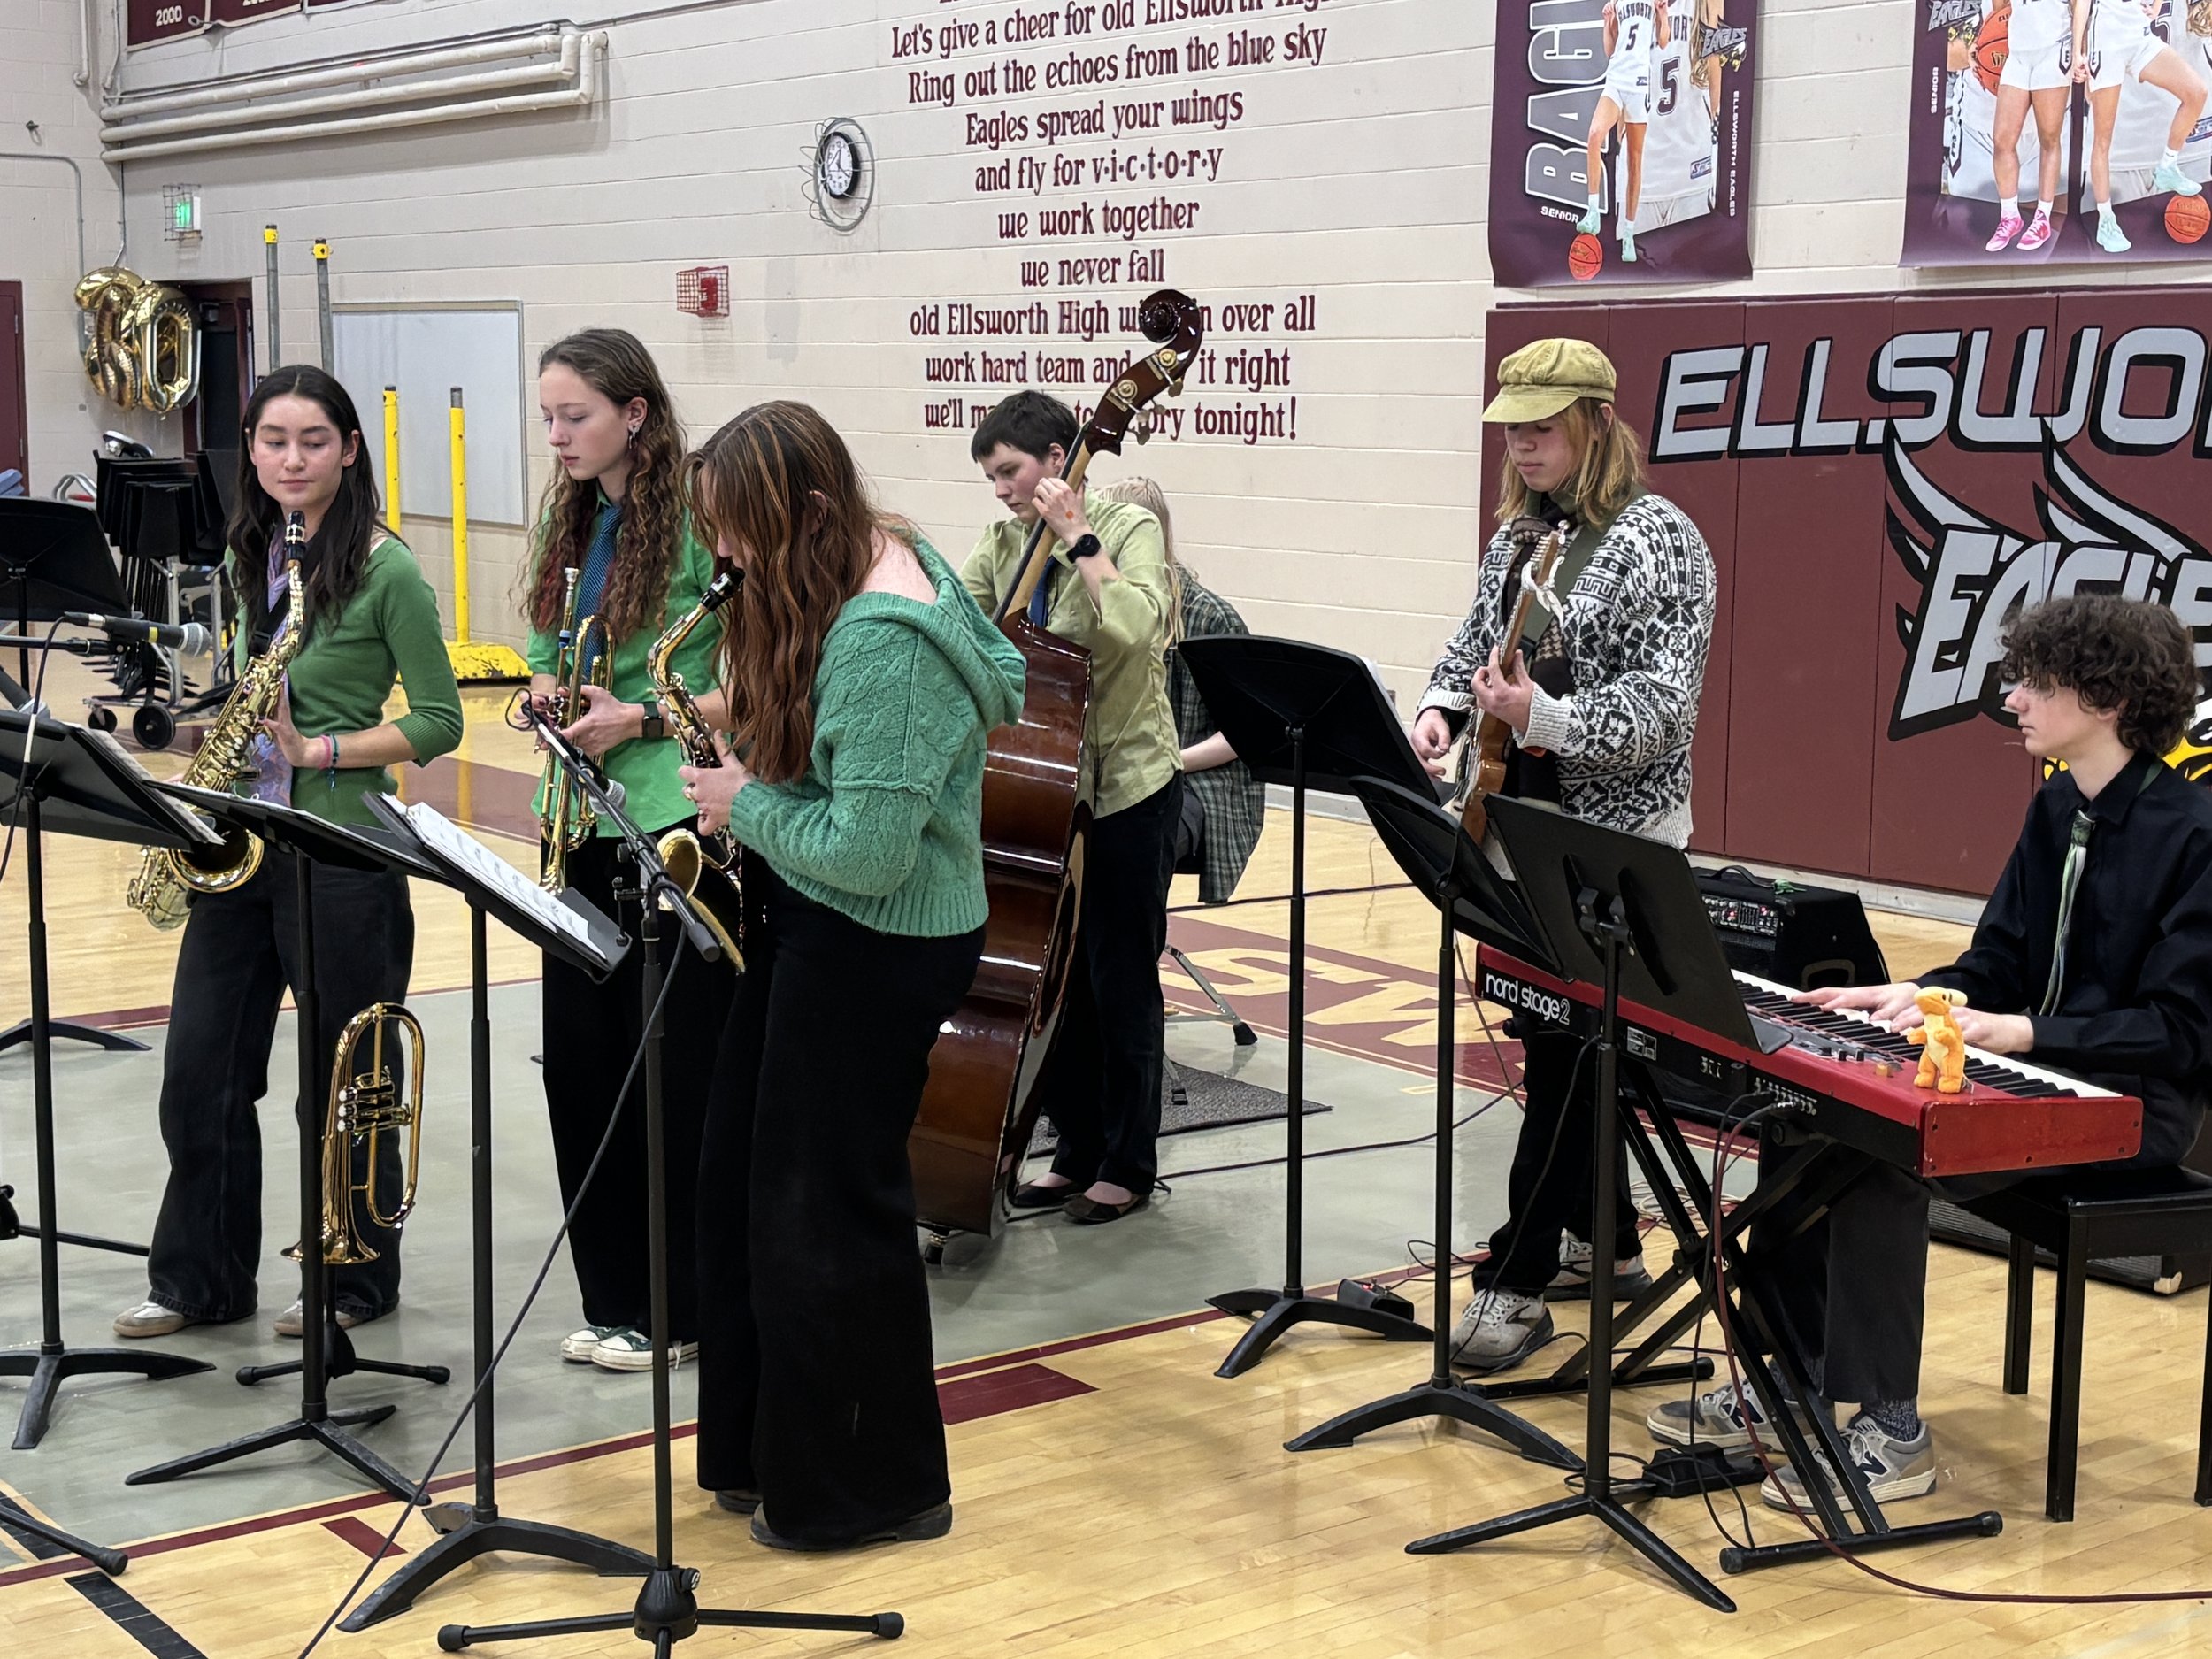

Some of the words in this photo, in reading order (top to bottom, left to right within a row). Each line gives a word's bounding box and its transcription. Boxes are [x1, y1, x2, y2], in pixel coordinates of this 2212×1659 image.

[155, 5, 183, 27] 2000
[892, 23, 932, 58] Let's
[939, 18, 979, 59] give
[986, 19, 998, 45] a
[1004, 8, 1060, 42] cheer
[1064, 1, 1096, 35] for
[1102, 0, 1135, 31] old
[1625, 23, 1640, 51] 5
[908, 70, 955, 107] Ring
[964, 61, 998, 97] out
[1003, 59, 1036, 94] the
[1046, 51, 1118, 89] echoes
[1125, 44, 1178, 79] from
[1186, 36, 1219, 72] the
[1227, 29, 1275, 67] blue
[1284, 22, 1327, 66] sky
[1656, 56, 1681, 116] 5
[1930, 66, 1939, 114] SENIOR
[965, 110, 1028, 151] Eagles
[1036, 99, 1105, 145] spread
[1112, 101, 1164, 139] your
[1171, 89, 1243, 130] wings
[1731, 90, 1740, 166] ELLSWORTH
[975, 158, 1010, 192] and
[1017, 156, 1047, 196] fly
[1053, 153, 1085, 186] for
[998, 211, 1028, 239] we
[1039, 202, 1095, 236] work
[1102, 196, 1200, 241] together
[1540, 205, 1579, 224] SENIOR
[1021, 259, 1049, 287] we
[1058, 257, 1121, 286] never
[1127, 249, 1165, 283] fall
[910, 304, 940, 336] old
[947, 301, 1048, 335] Ellsworth
[1057, 299, 1110, 342] High
[1222, 302, 1275, 332] over
[1284, 295, 1316, 331] all
[926, 351, 977, 382] work
[981, 351, 1028, 383] hard
[1036, 350, 1085, 383] team
[1093, 349, 1132, 383] and
[1198, 348, 1217, 384] it
[1225, 347, 1291, 393] right
[1653, 326, 2212, 458] ELLSWO
[925, 398, 964, 428] we'll
[1194, 396, 1296, 444] tonight!
[1486, 972, 1518, 1005] nord
